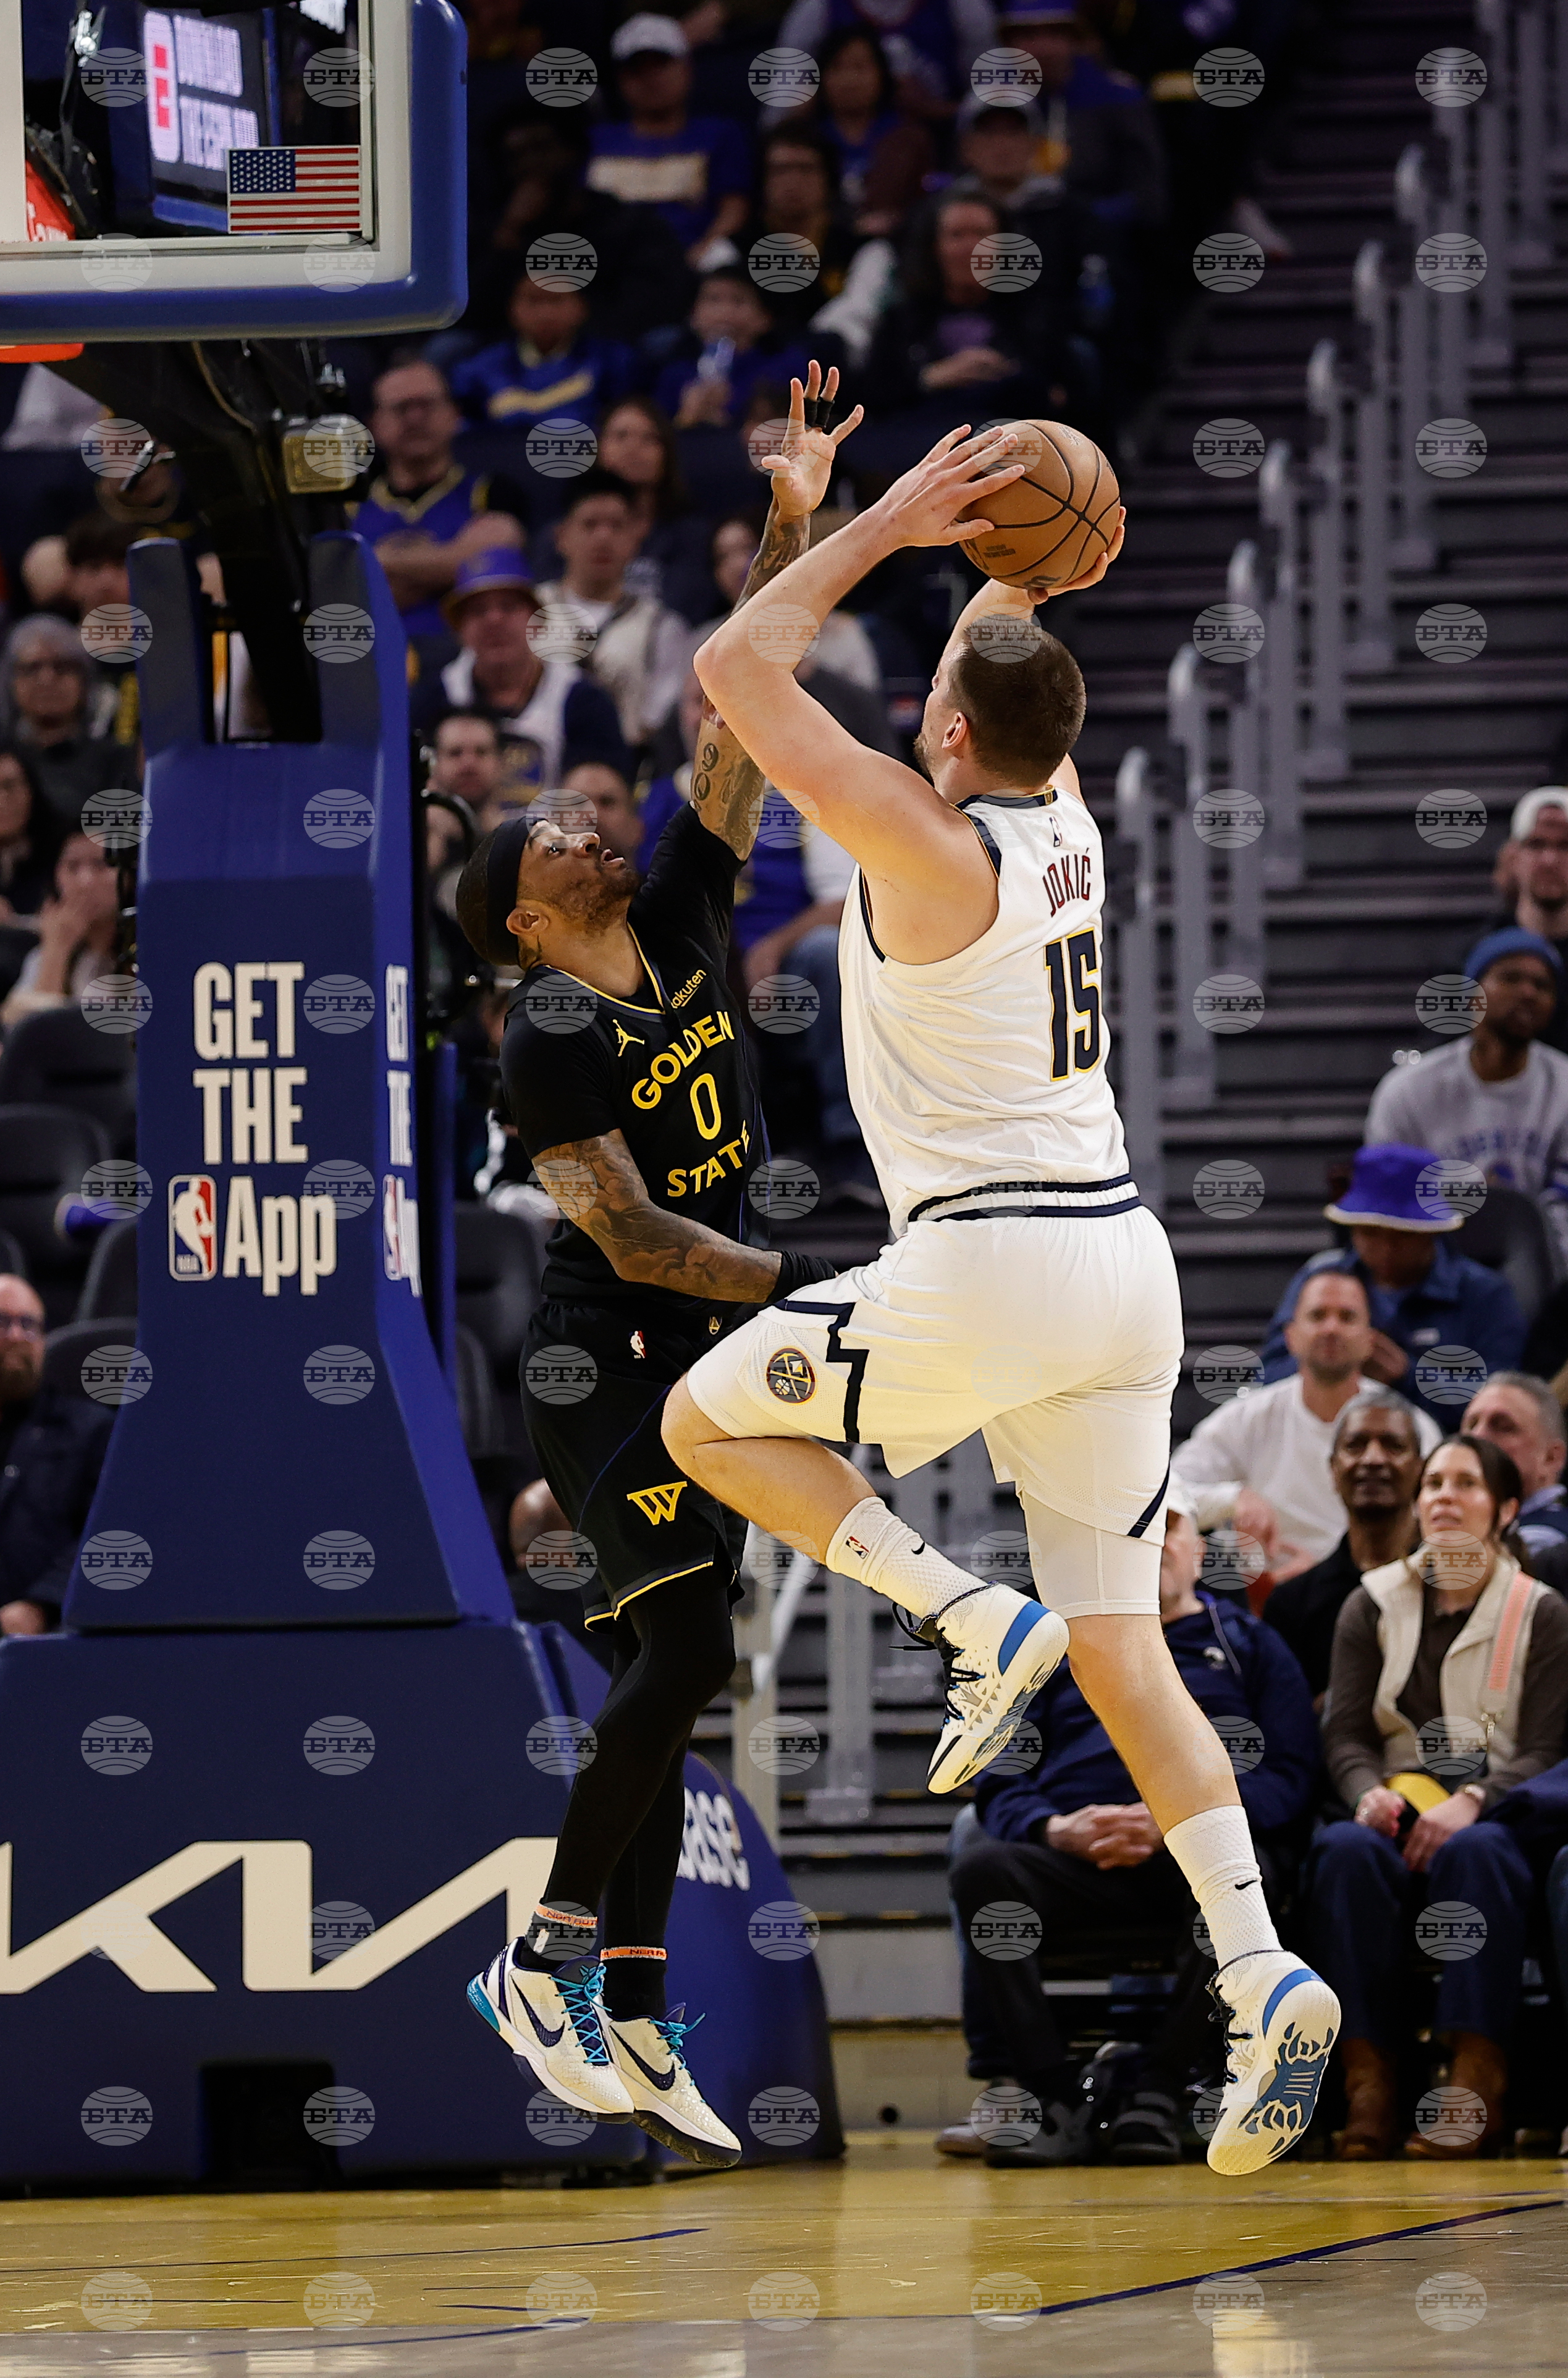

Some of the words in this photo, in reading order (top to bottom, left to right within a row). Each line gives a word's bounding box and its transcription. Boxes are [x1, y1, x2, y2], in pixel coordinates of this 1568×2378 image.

[1042, 847, 1091, 917] JOKIĆ
[193, 961, 305, 1061] GET
[1043, 926, 1101, 1082] 15
[631, 1011, 735, 1110] GOLDEN
[689, 1073, 722, 1141] 0
[193, 1067, 308, 1165] THE
[667, 1119, 750, 1197] STATE
[222, 1175, 337, 1296] App
